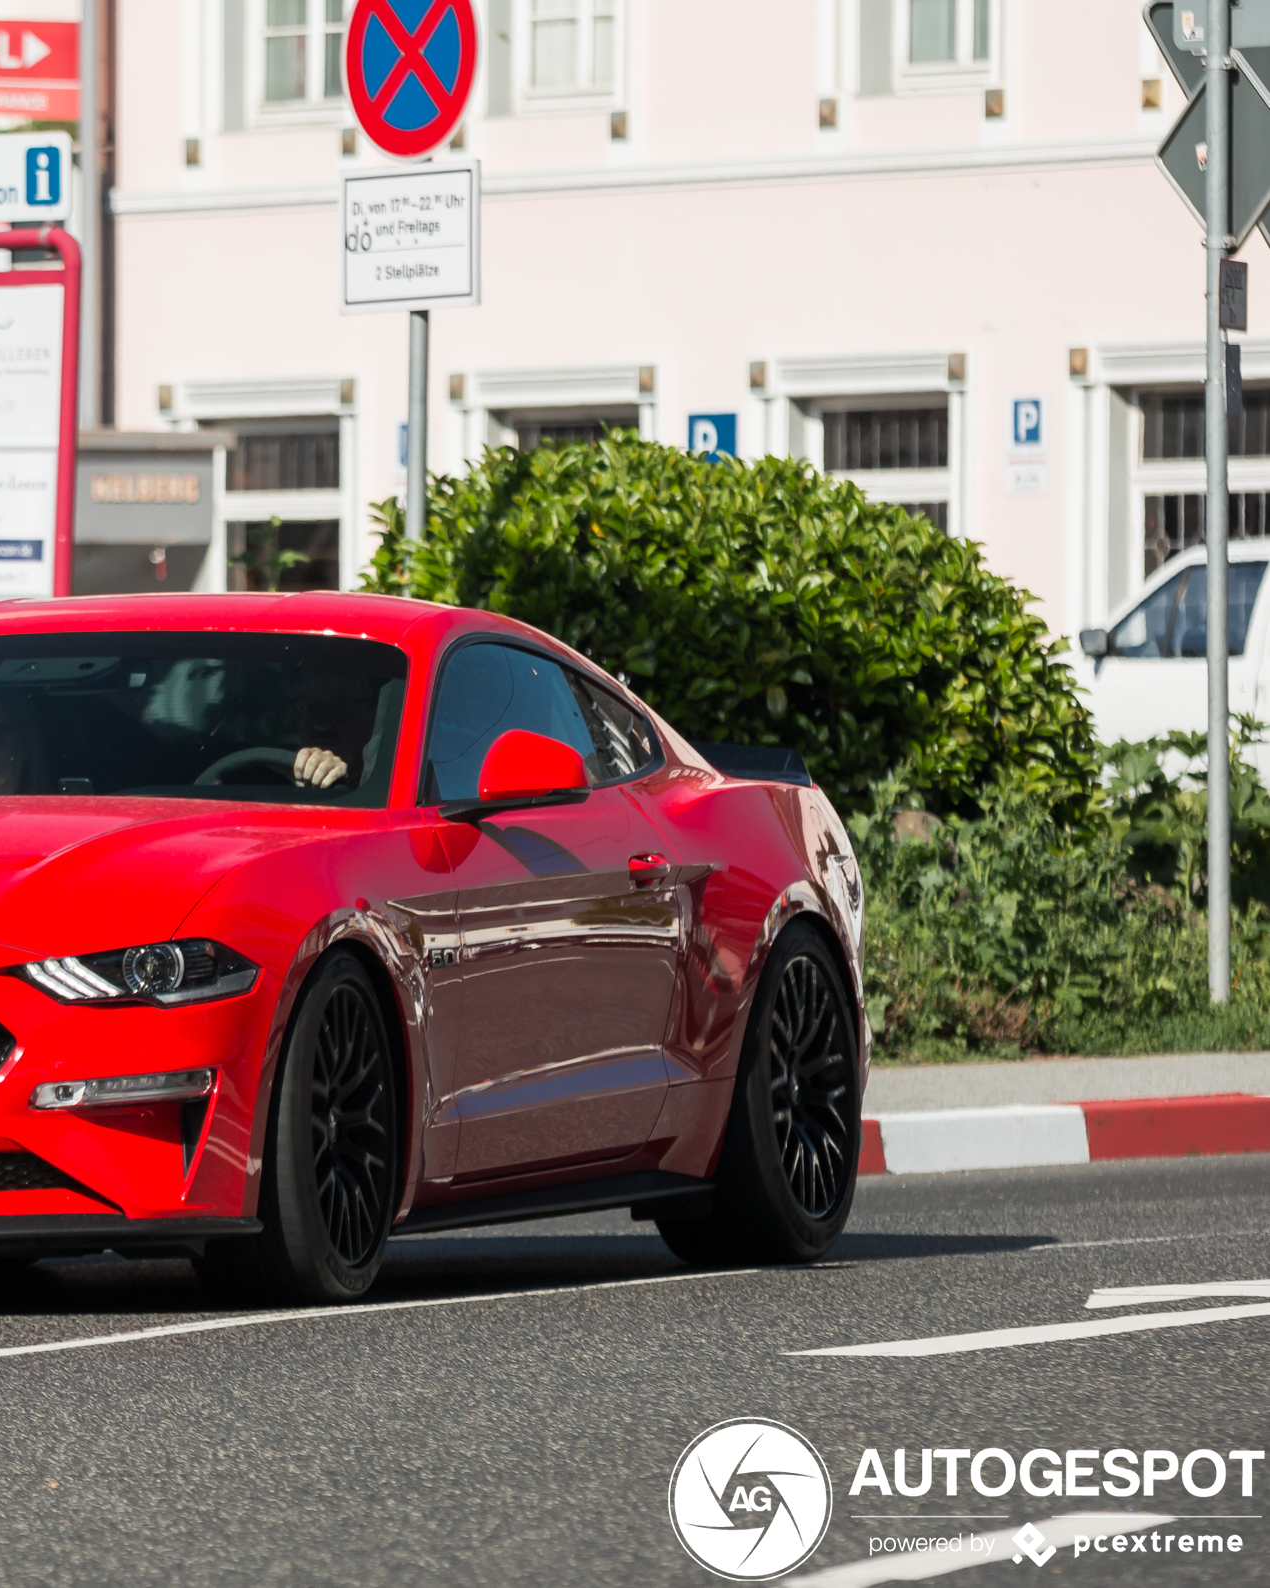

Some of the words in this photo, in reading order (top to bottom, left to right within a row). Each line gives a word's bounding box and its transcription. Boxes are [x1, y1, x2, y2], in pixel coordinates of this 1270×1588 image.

[369, 203, 386, 214] von
[446, 194, 465, 209] Uhr
[376, 221, 395, 236] und
[398, 219, 440, 236] Freitags
[376, 267, 382, 280] 2
[385, 263, 440, 282] Stellplätze
[1017, 402, 1039, 443] P
